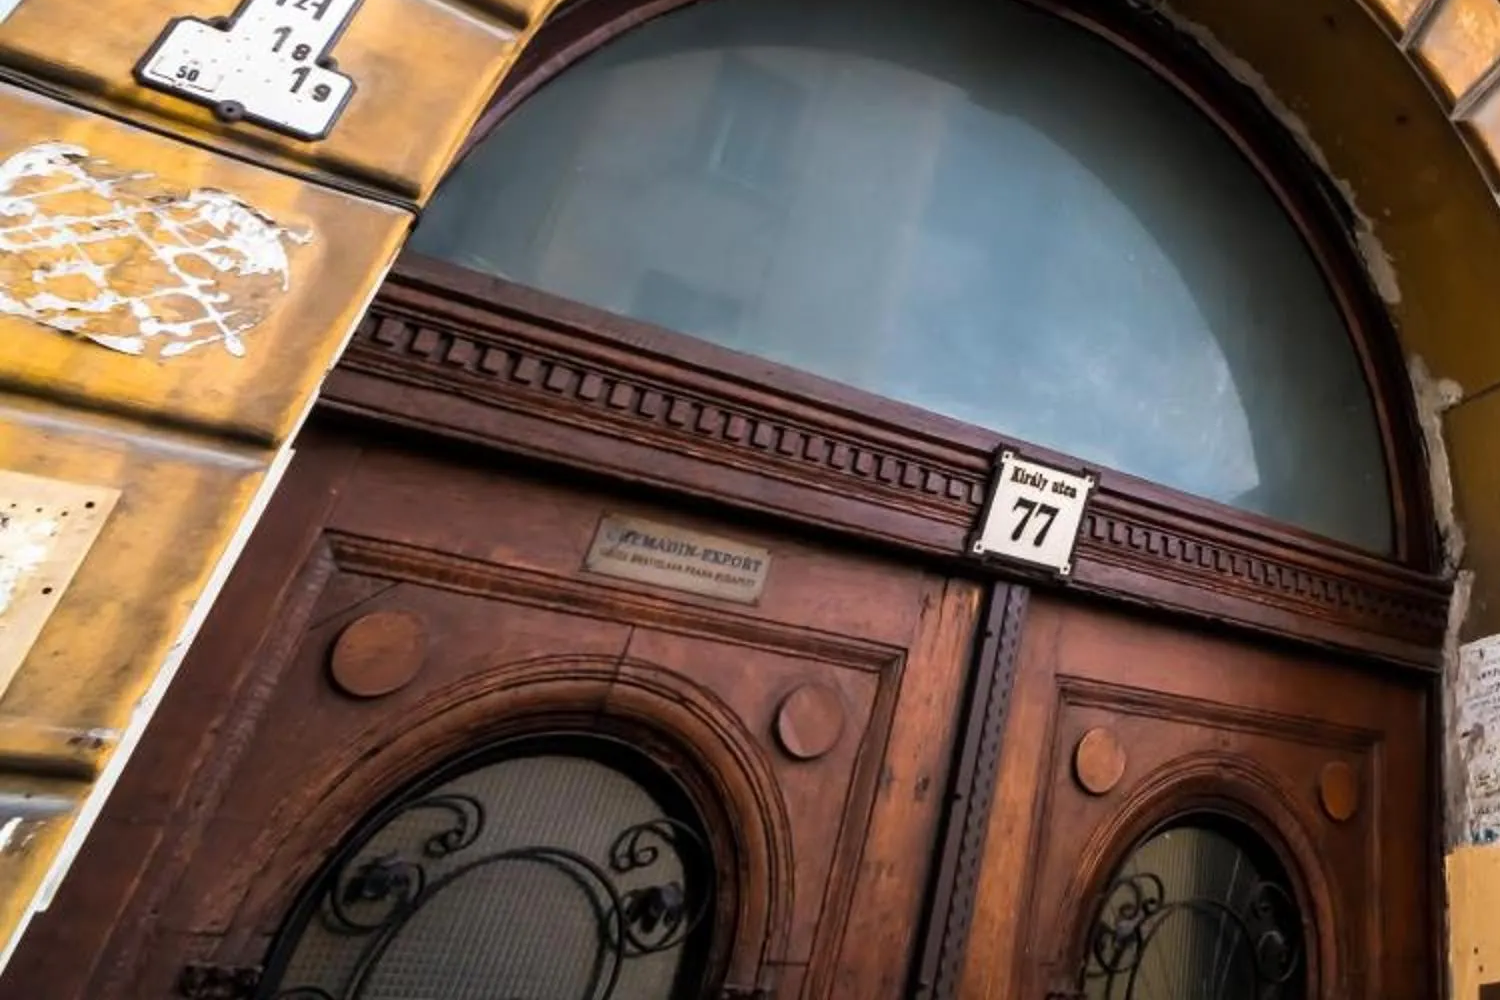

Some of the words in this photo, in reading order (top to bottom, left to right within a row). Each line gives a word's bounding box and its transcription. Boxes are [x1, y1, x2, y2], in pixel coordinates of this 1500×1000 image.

[1010, 465, 1048, 492] Király
[1051, 480, 1077, 499] utca
[1011, 497, 1060, 547] 77
